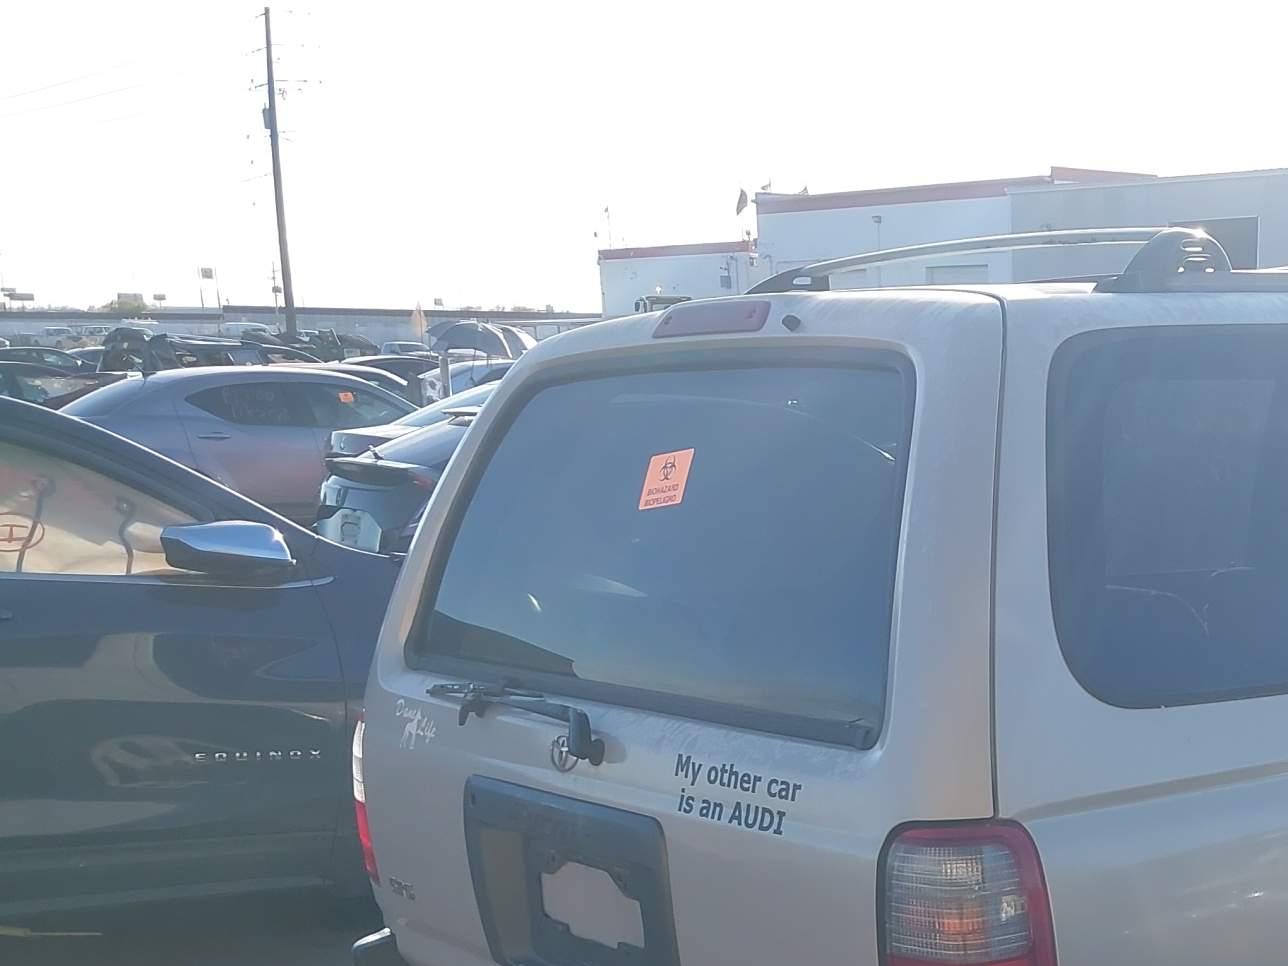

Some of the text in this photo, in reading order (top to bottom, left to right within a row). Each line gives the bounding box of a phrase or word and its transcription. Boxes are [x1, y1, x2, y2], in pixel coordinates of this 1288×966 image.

[194, 749, 321, 762] EQUINOX
[674, 753, 802, 801] My other car
[678, 787, 787, 835] is an AUDI
